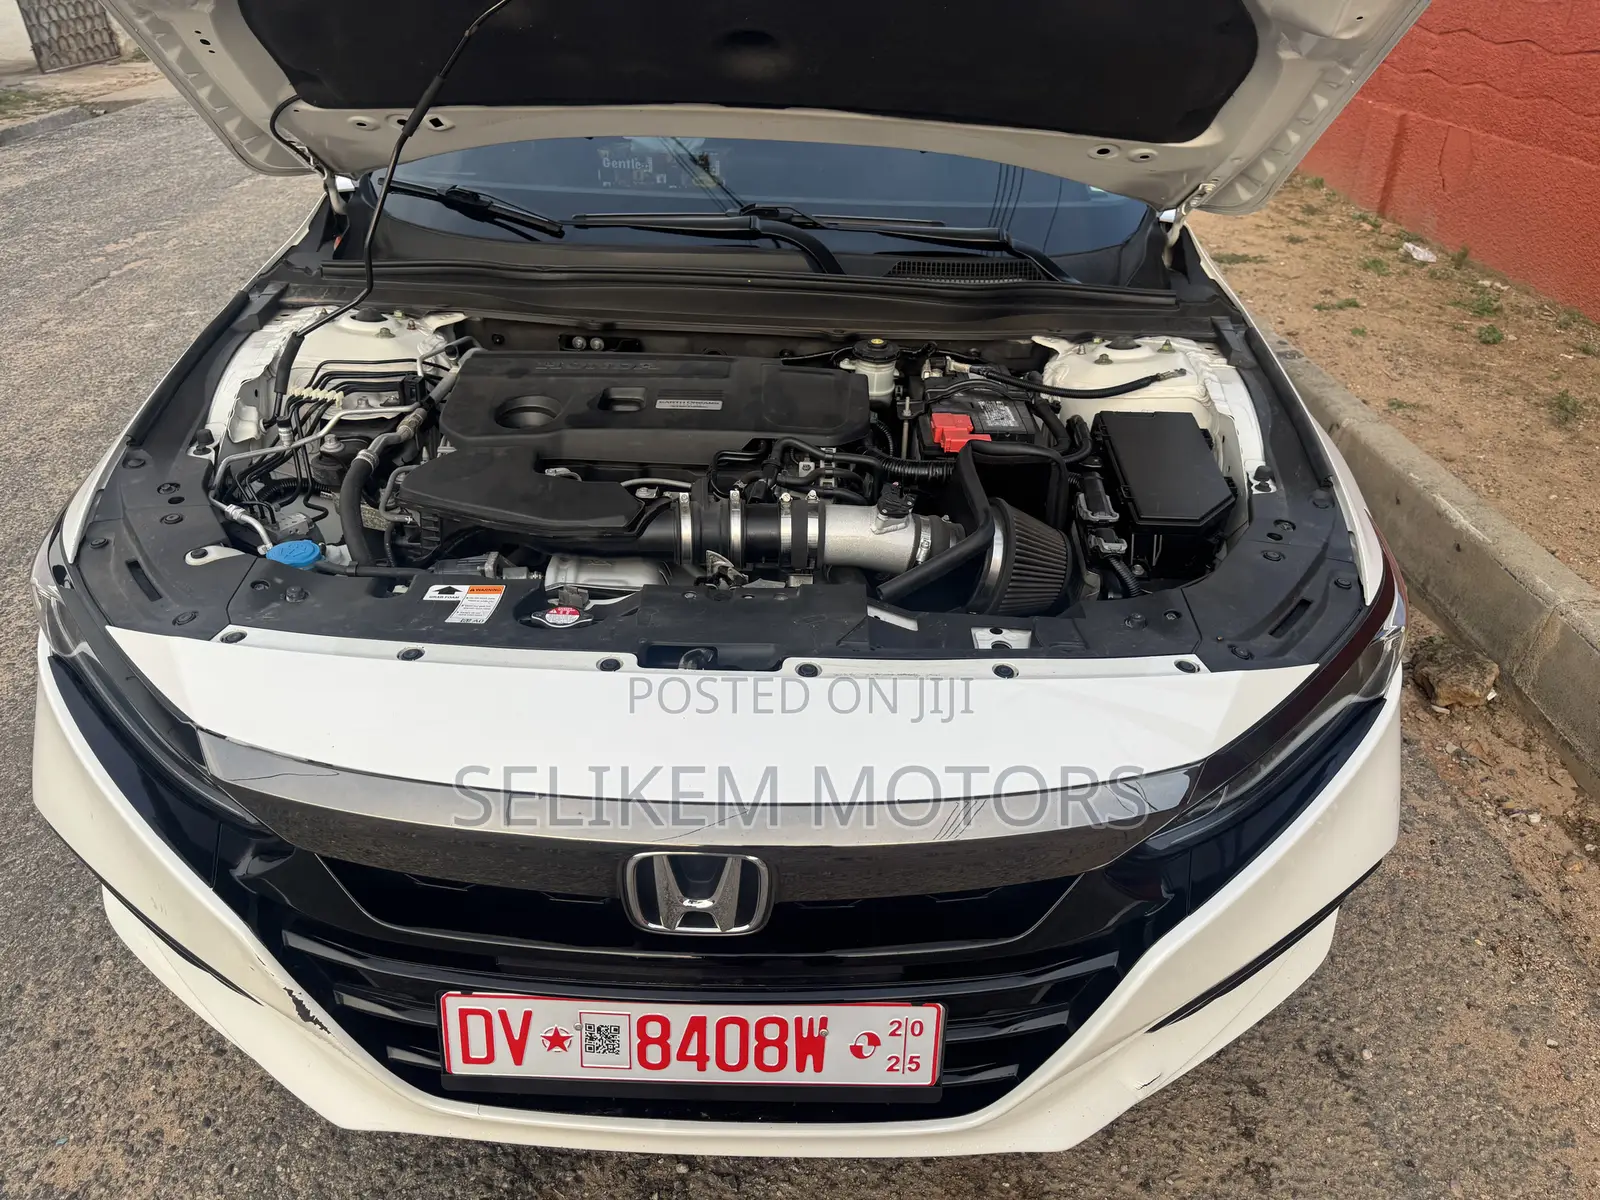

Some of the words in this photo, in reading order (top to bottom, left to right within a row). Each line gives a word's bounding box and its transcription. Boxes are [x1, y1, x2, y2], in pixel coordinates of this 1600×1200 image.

[888, 1019, 924, 1037] 20
[458, 1006, 533, 1066] DV
[636, 1013, 829, 1074] 8408W
[886, 1054, 921, 1072] 25
